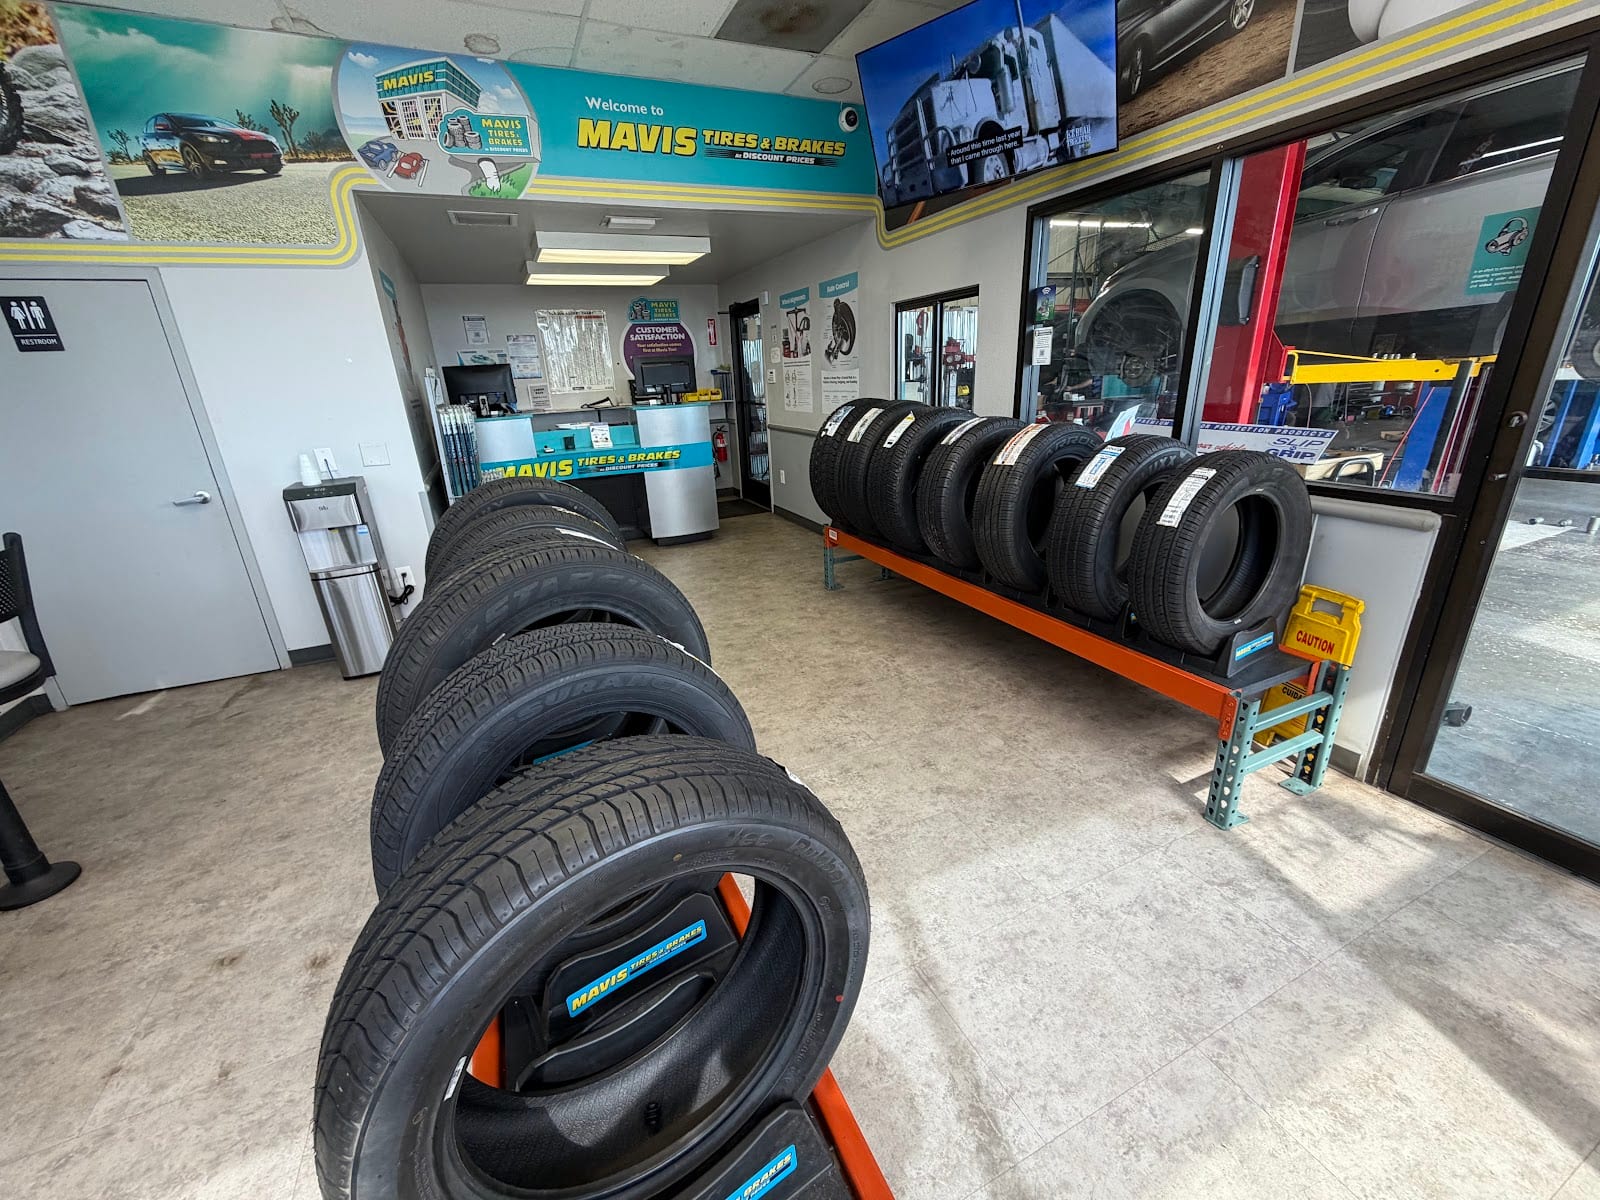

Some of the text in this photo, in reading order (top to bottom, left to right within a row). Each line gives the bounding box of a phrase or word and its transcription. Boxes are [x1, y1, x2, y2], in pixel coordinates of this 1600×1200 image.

[383, 70, 434, 91] MAVIS
[585, 96, 664, 116] Welcome to
[481, 118, 521, 129] MAVIS
[488, 129, 515, 138] TIRES
[577, 118, 698, 156] MAVIS
[489, 138, 522, 146] BRAKES
[702, 129, 846, 156] TIRES & BRAKES
[951, 144, 970, 156] Around
[996, 134, 1007, 143] last
[1008, 130, 1021, 141] year
[981, 144, 1004, 156] through
[743, 152, 785, 162] DISCOUNT
[786, 156, 815, 164] PRICES
[630, 333, 686, 341] SATISFACTION
[635, 326, 679, 334] CUSTOMER
[1136, 418, 1171, 426] PREMIUM
[1215, 424, 1271, 433] PROTECTION
[1275, 428, 1334, 438] PRODUCTS
[1273, 438, 1325, 448] SLIP
[578, 450, 681, 466] TIRES & BRAKES
[1265, 448, 1316, 460] GRIP
[496, 459, 574, 478] MAVIS
[1296, 630, 1335, 655] CAUTION
[1282, 686, 1306, 700] CUIDA
[630, 951, 658, 970] TIRES
[666, 926, 703, 949] BRAKES
[571, 967, 628, 1012] MAVIS
[743, 1153, 792, 1198] BRAKES
